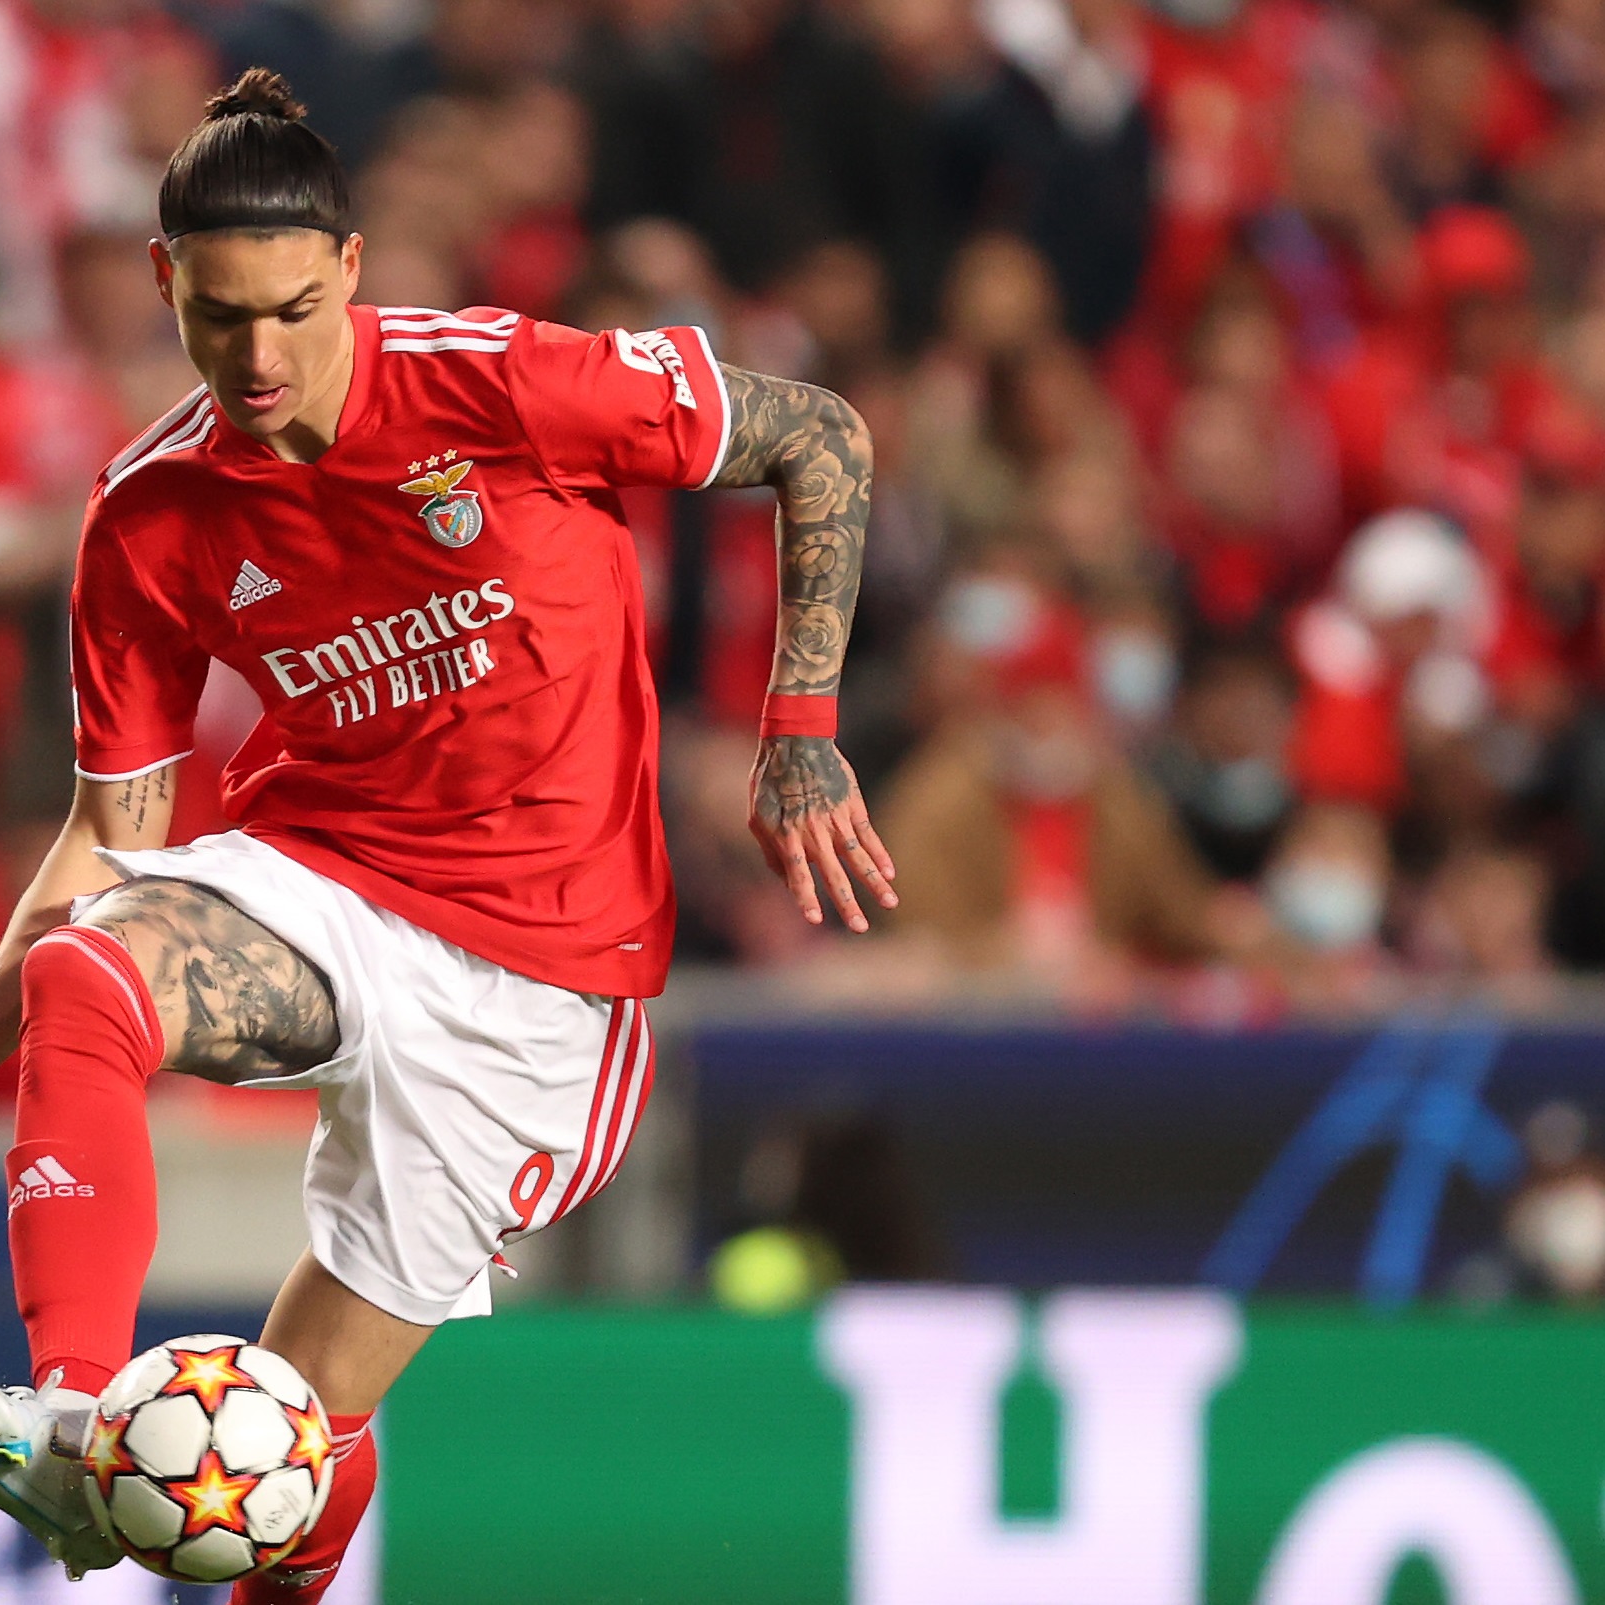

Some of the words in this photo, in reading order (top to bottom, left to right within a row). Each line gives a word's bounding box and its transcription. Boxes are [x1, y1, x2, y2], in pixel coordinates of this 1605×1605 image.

[229, 577, 283, 612] adidas
[261, 577, 516, 699] Emirates
[327, 674, 377, 728] FLY
[385, 637, 497, 709] BETTER
[7, 1183, 96, 1221] didas
[496, 1151, 555, 1242] 9
